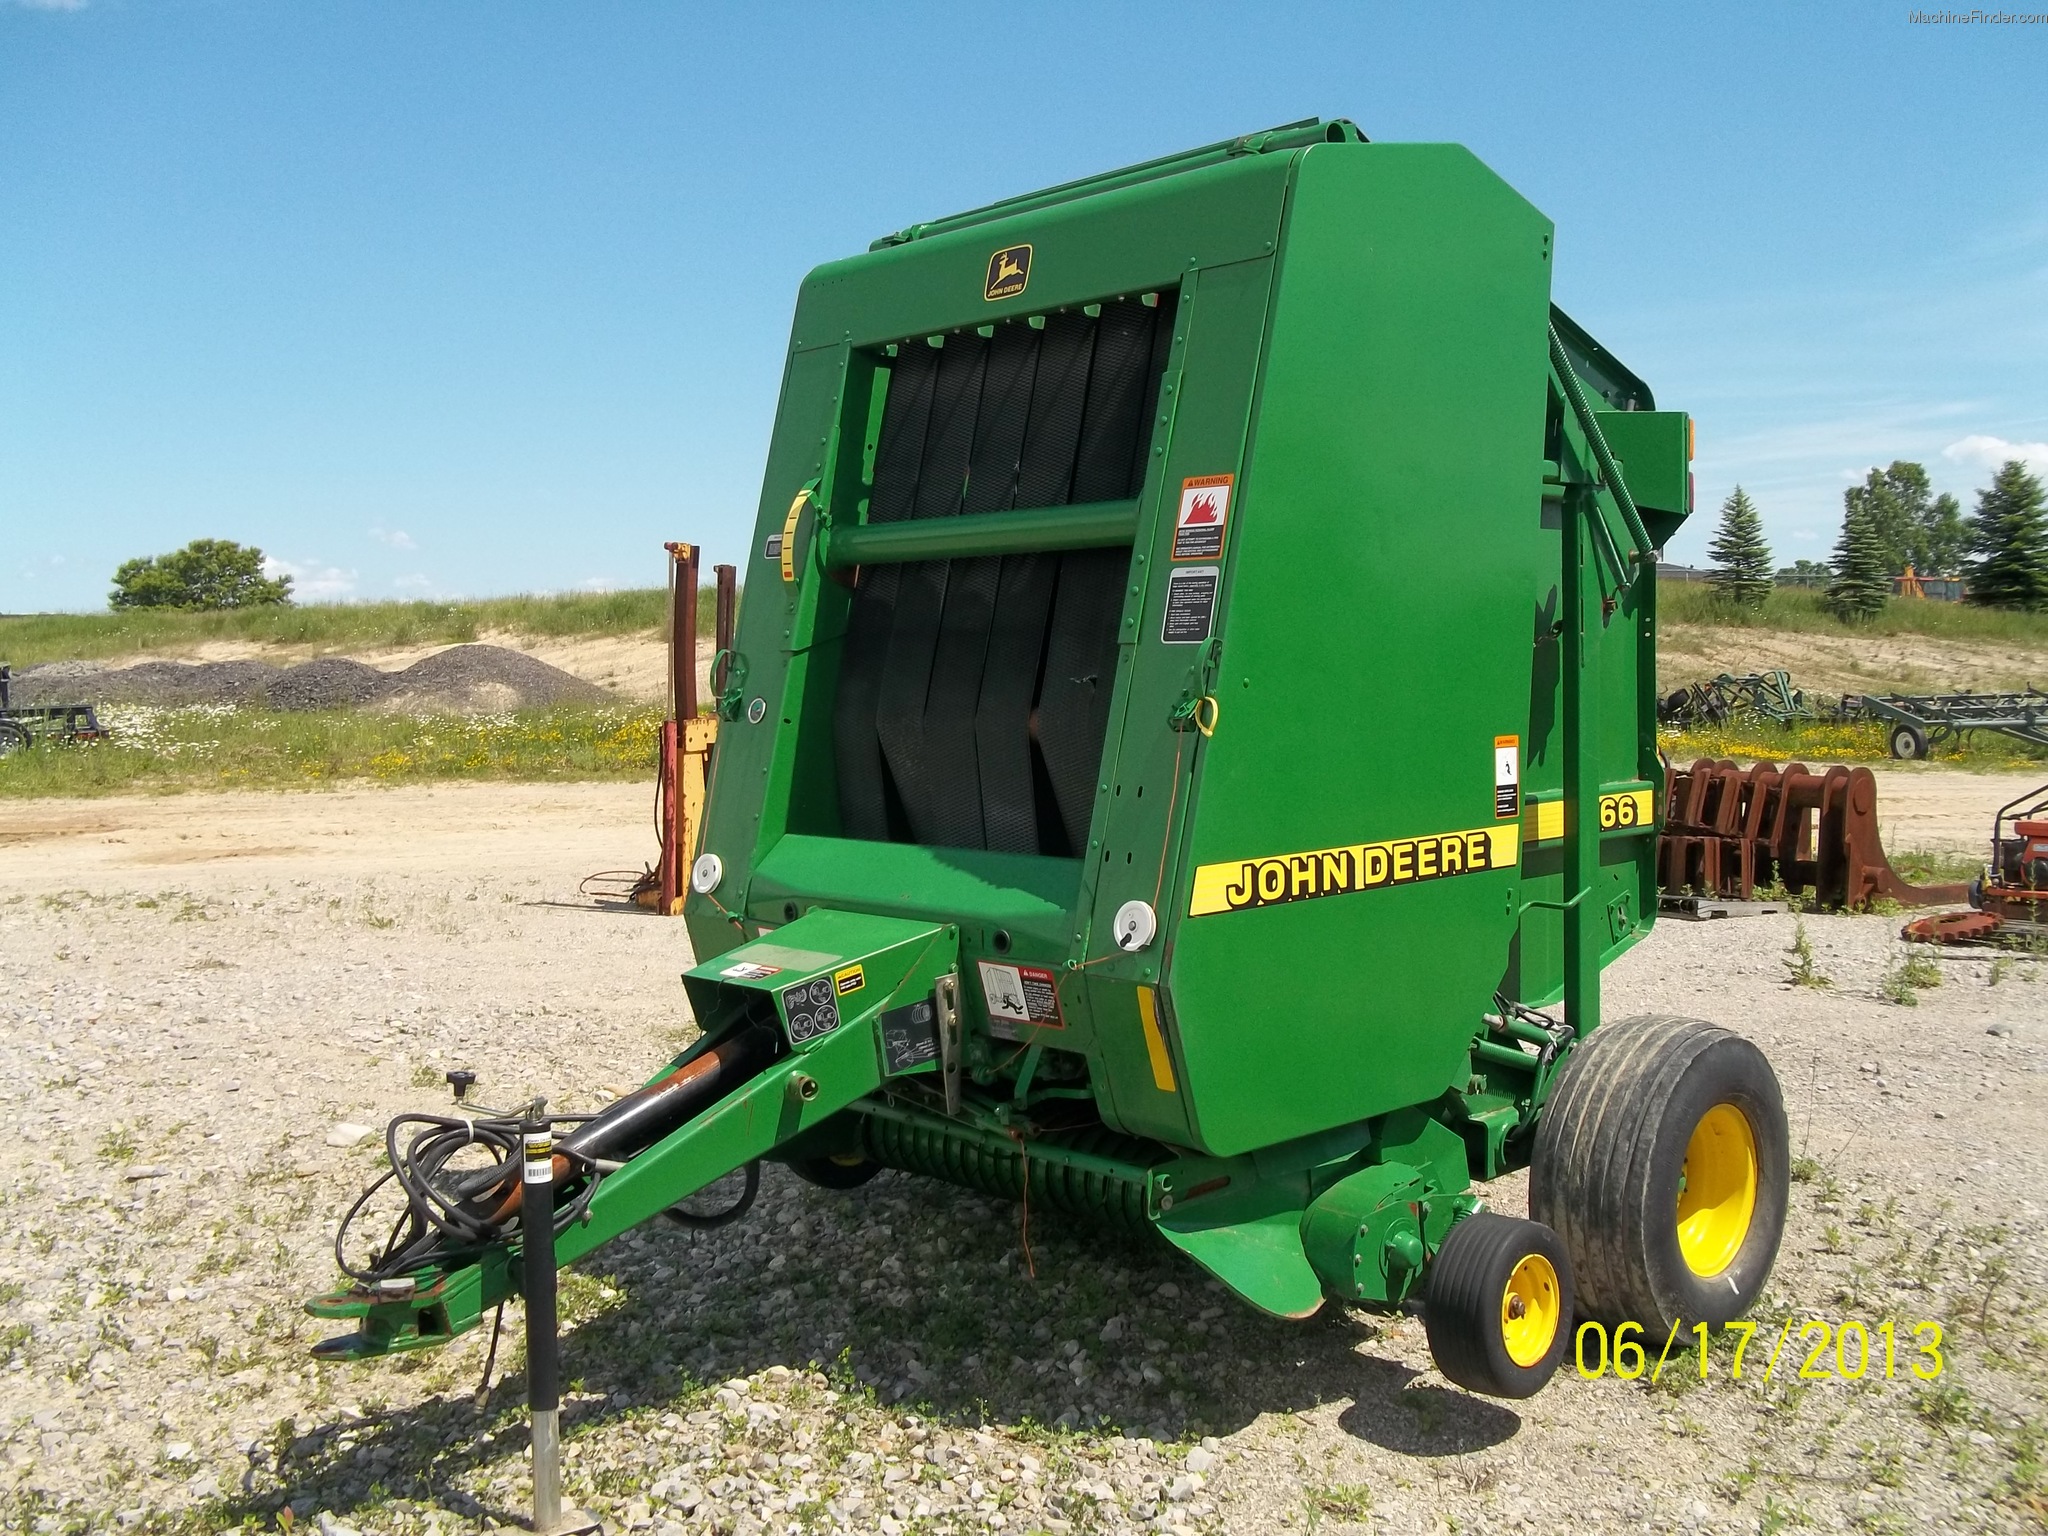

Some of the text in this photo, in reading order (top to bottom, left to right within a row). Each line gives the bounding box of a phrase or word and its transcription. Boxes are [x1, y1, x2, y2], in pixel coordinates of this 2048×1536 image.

[987, 283, 1022, 297] JOHN DEERE
[1194, 476, 1228, 486] WARNING
[1227, 832, 1490, 907] JOHN DEERE
[1029, 971, 1048, 979] DANGER
